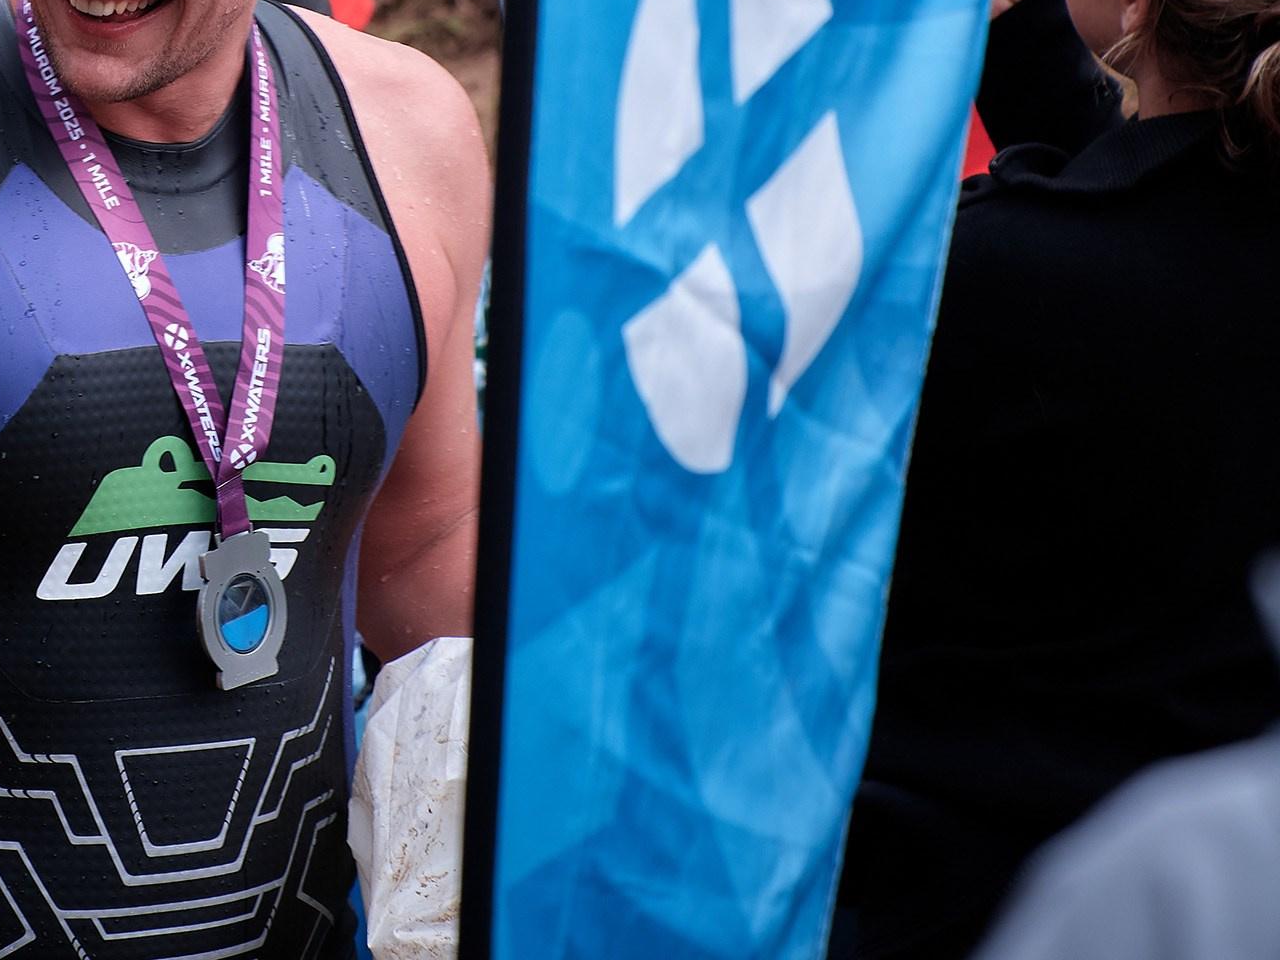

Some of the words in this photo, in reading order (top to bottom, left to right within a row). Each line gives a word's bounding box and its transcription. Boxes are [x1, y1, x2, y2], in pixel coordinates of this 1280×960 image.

[26, 26, 63, 96] MUROM
[256, 52, 272, 122] MUROM
[54, 97, 85, 141] 2025
[82, 152, 97, 163] 1
[260, 139, 272, 185] MILE
[87, 164, 121, 210] MILE
[260, 189, 272, 197] 1
